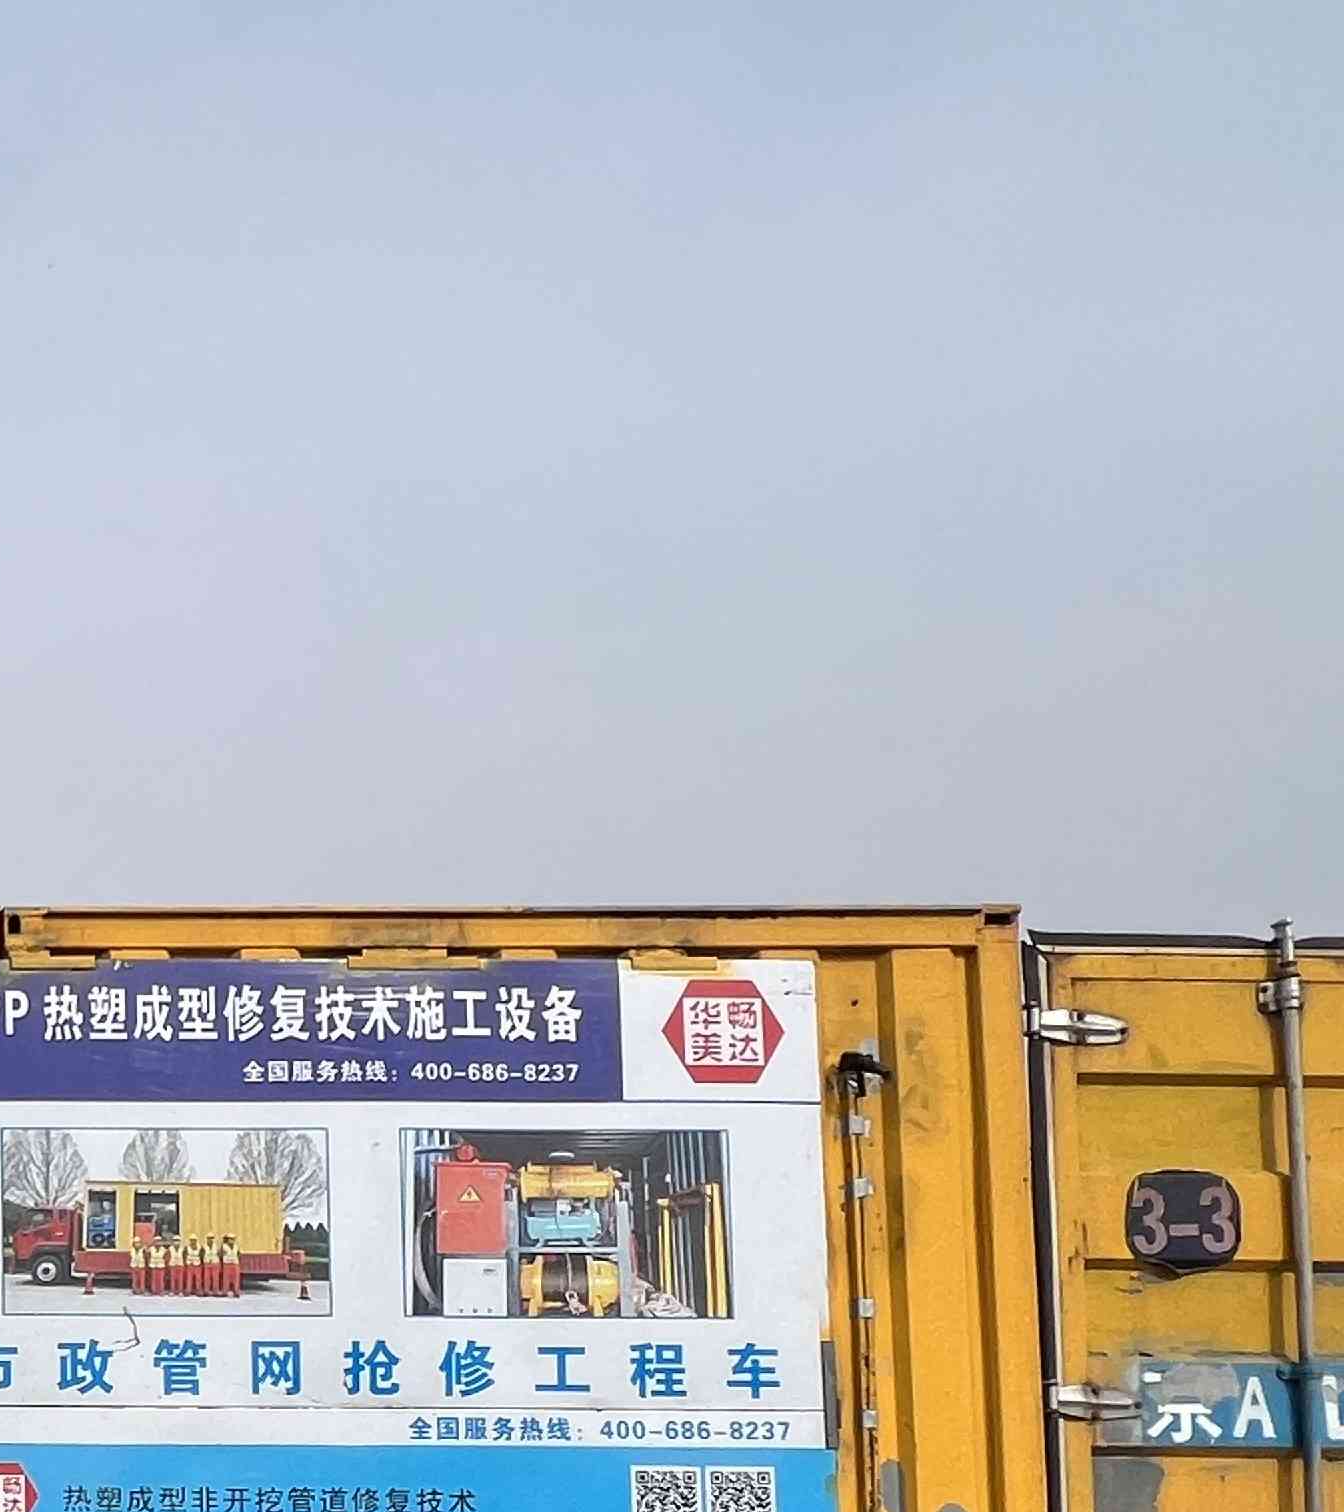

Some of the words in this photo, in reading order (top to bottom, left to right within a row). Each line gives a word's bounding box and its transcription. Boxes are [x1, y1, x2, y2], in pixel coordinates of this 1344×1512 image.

[42, 984, 582, 1042] 热塑成型修复技术施工设备
[1131, 1185, 1237, 1256] 3-3
